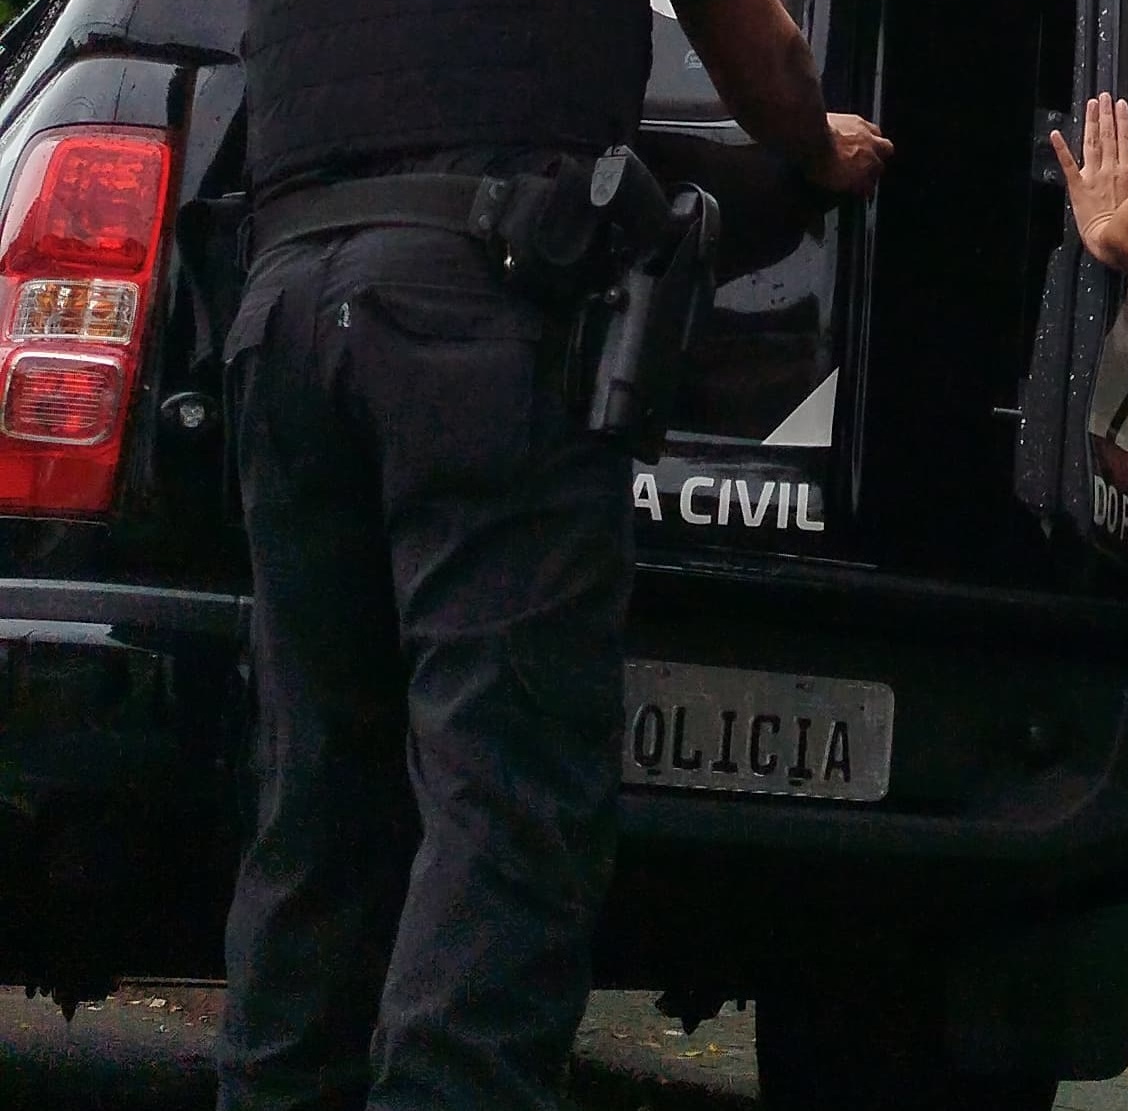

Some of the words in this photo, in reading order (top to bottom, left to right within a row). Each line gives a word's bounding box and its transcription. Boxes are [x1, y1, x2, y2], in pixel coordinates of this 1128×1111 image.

[632, 472, 663, 521] A
[679, 476, 825, 532] CIVIL
[1092, 474, 1118, 535] DO
